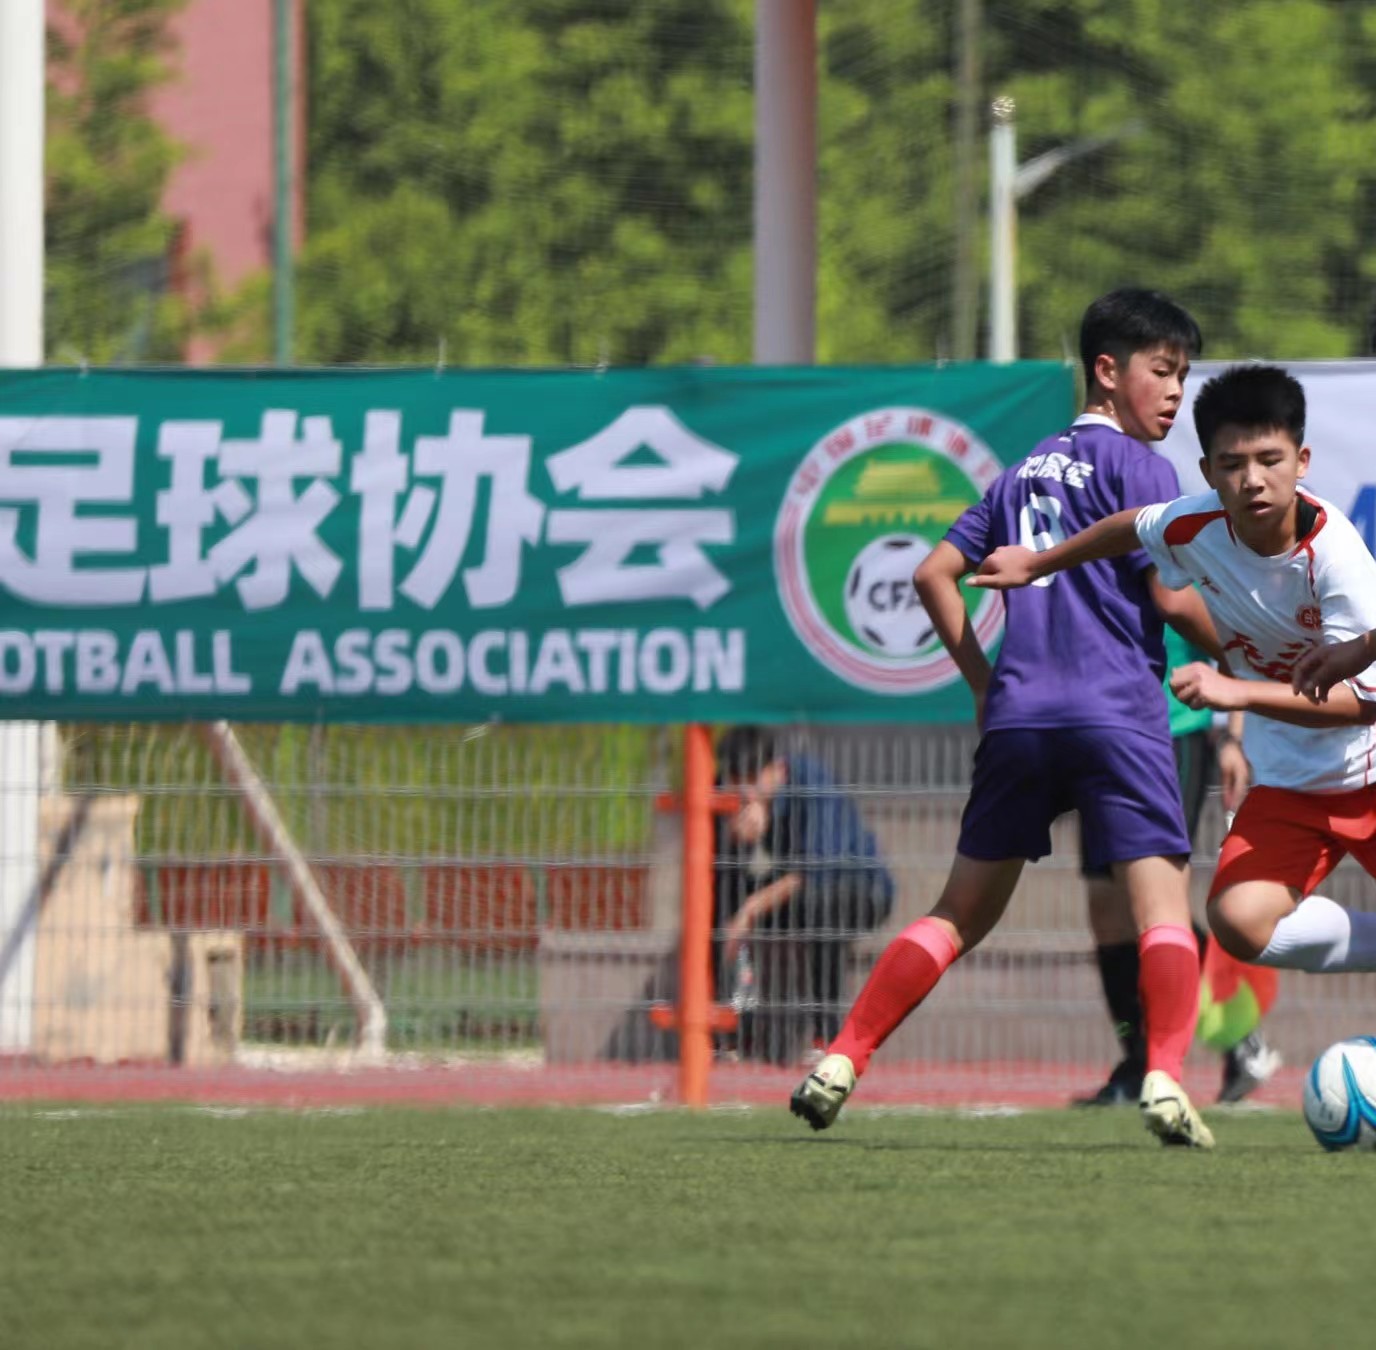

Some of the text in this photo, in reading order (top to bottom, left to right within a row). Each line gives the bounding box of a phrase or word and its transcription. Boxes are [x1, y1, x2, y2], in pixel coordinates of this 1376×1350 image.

[0, 405, 740, 611] 足球协会
[280, 629, 747, 696] ASSOCIATION
